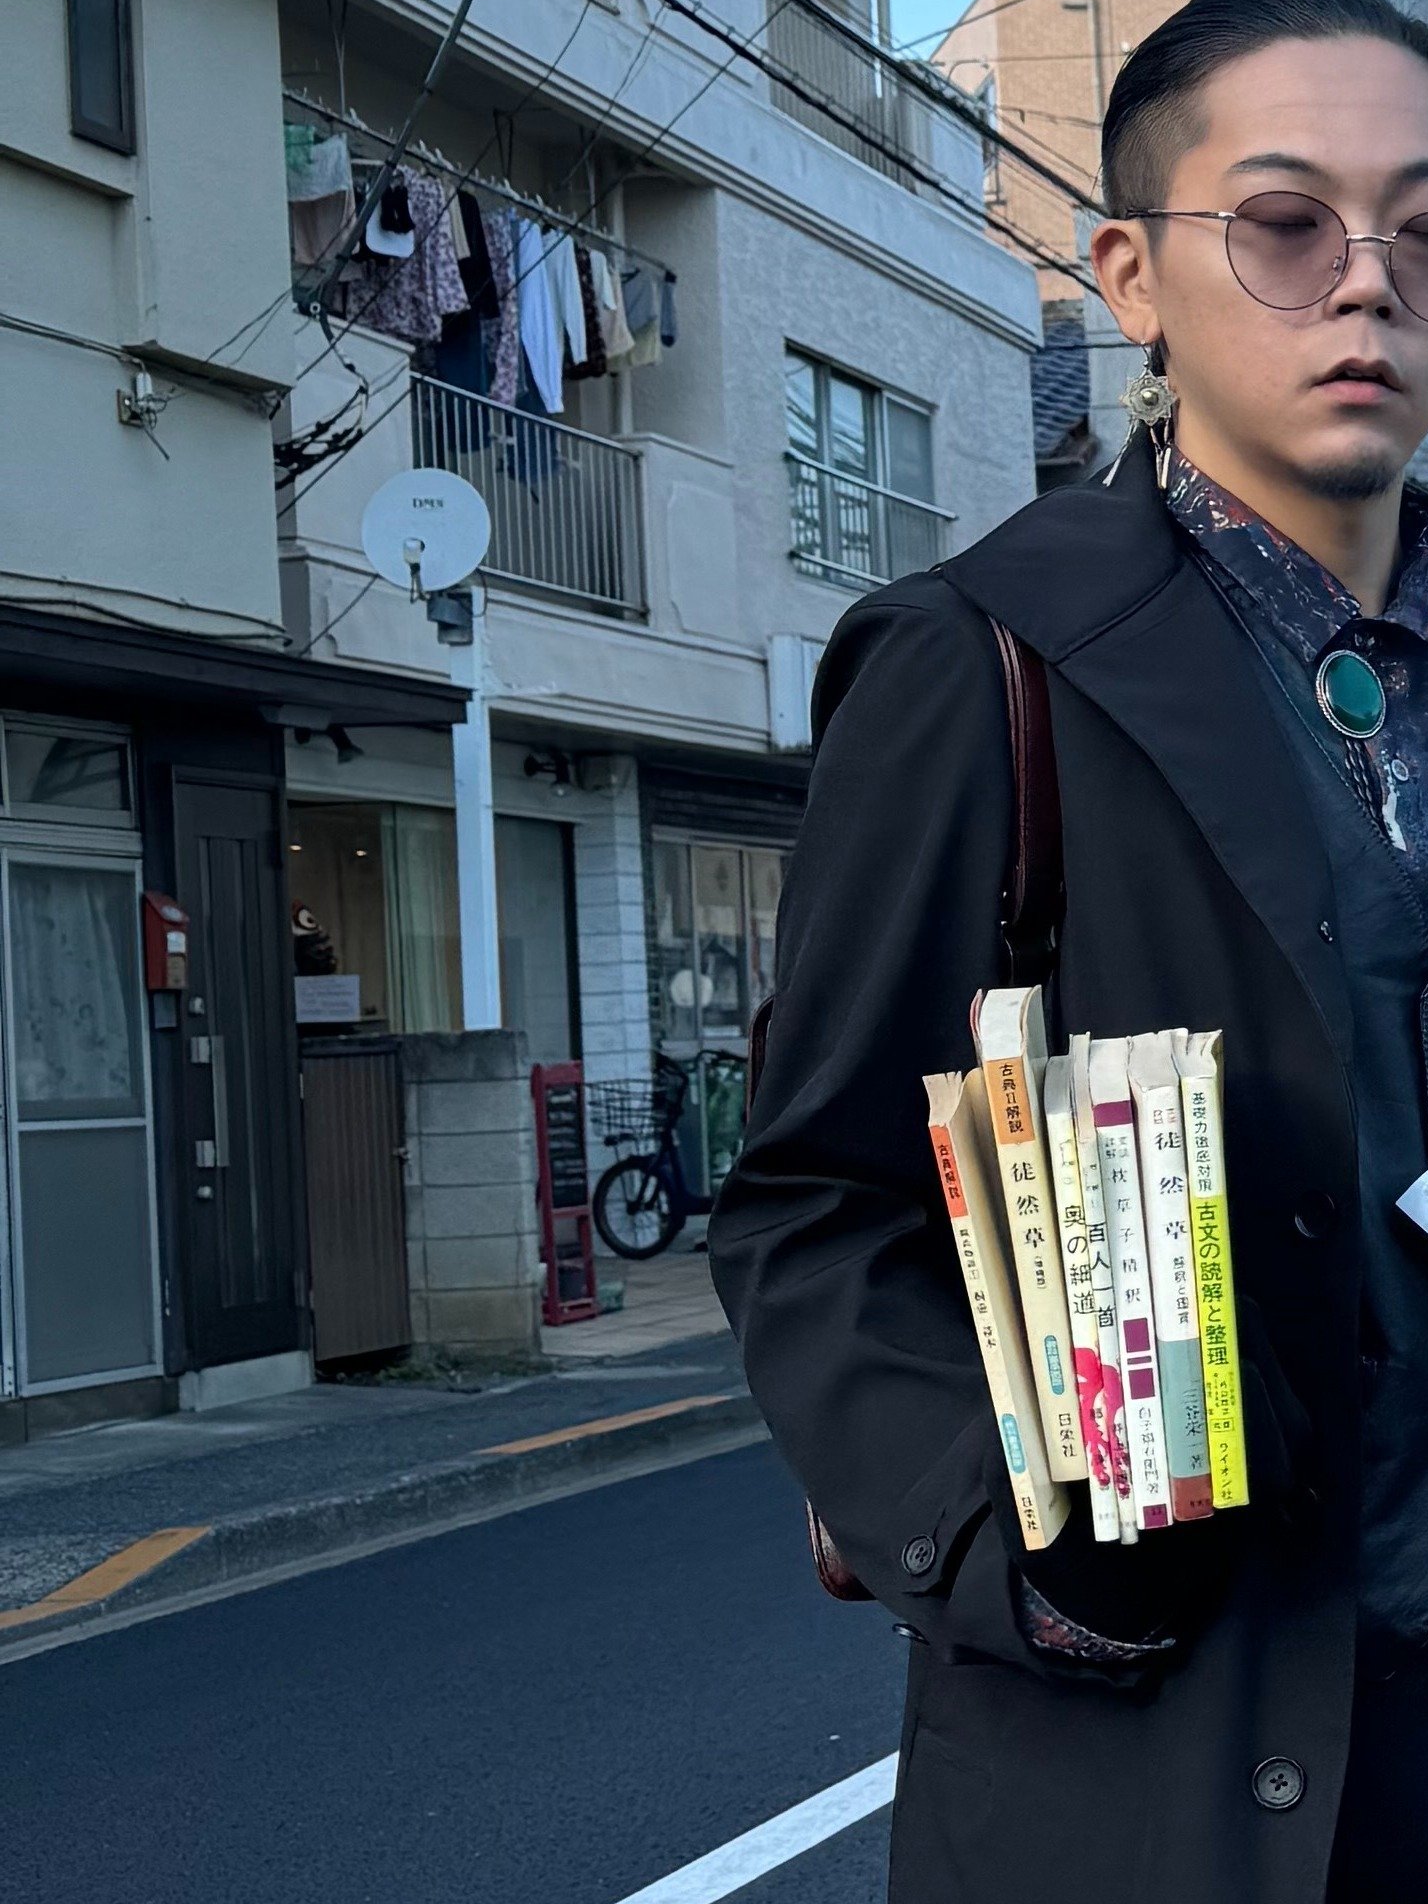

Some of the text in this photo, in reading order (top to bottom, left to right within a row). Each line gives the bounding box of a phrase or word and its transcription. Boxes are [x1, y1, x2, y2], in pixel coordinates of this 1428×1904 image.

[1010, 1162, 1045, 1248] 徒然草
[1064, 1204, 1096, 1315] 奥の細道
[1088, 1221, 1116, 1328] 百人一首
[1196, 1201, 1230, 1366] 古文の読解と整理
